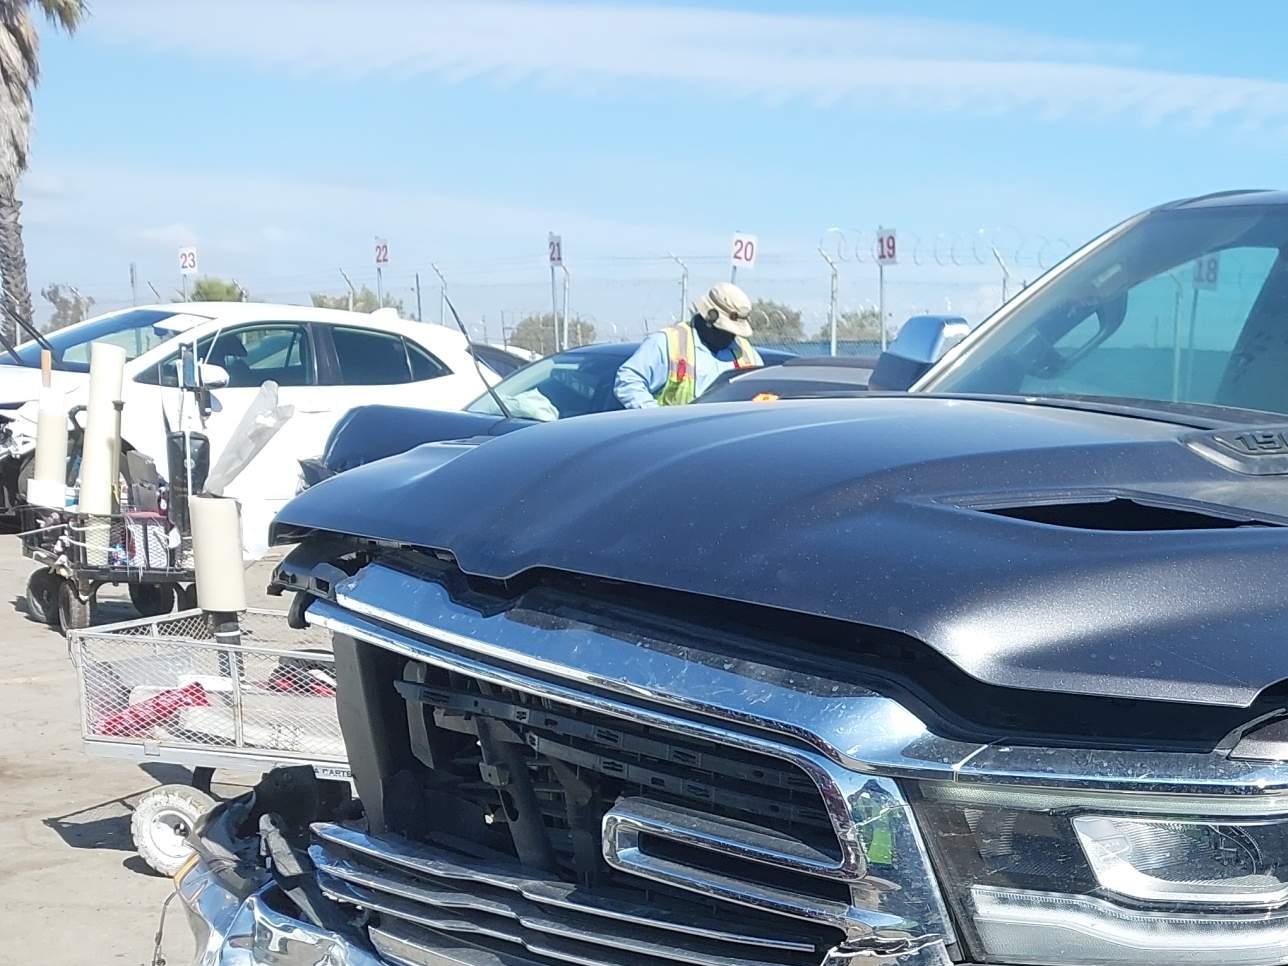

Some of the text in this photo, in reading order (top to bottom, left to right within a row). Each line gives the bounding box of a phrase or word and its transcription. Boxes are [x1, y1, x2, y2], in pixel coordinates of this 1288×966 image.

[375, 244, 389, 263] 22
[549, 241, 562, 261] 21
[733, 239, 754, 262] 20
[878, 235, 896, 259] 19
[180, 252, 196, 269] 23
